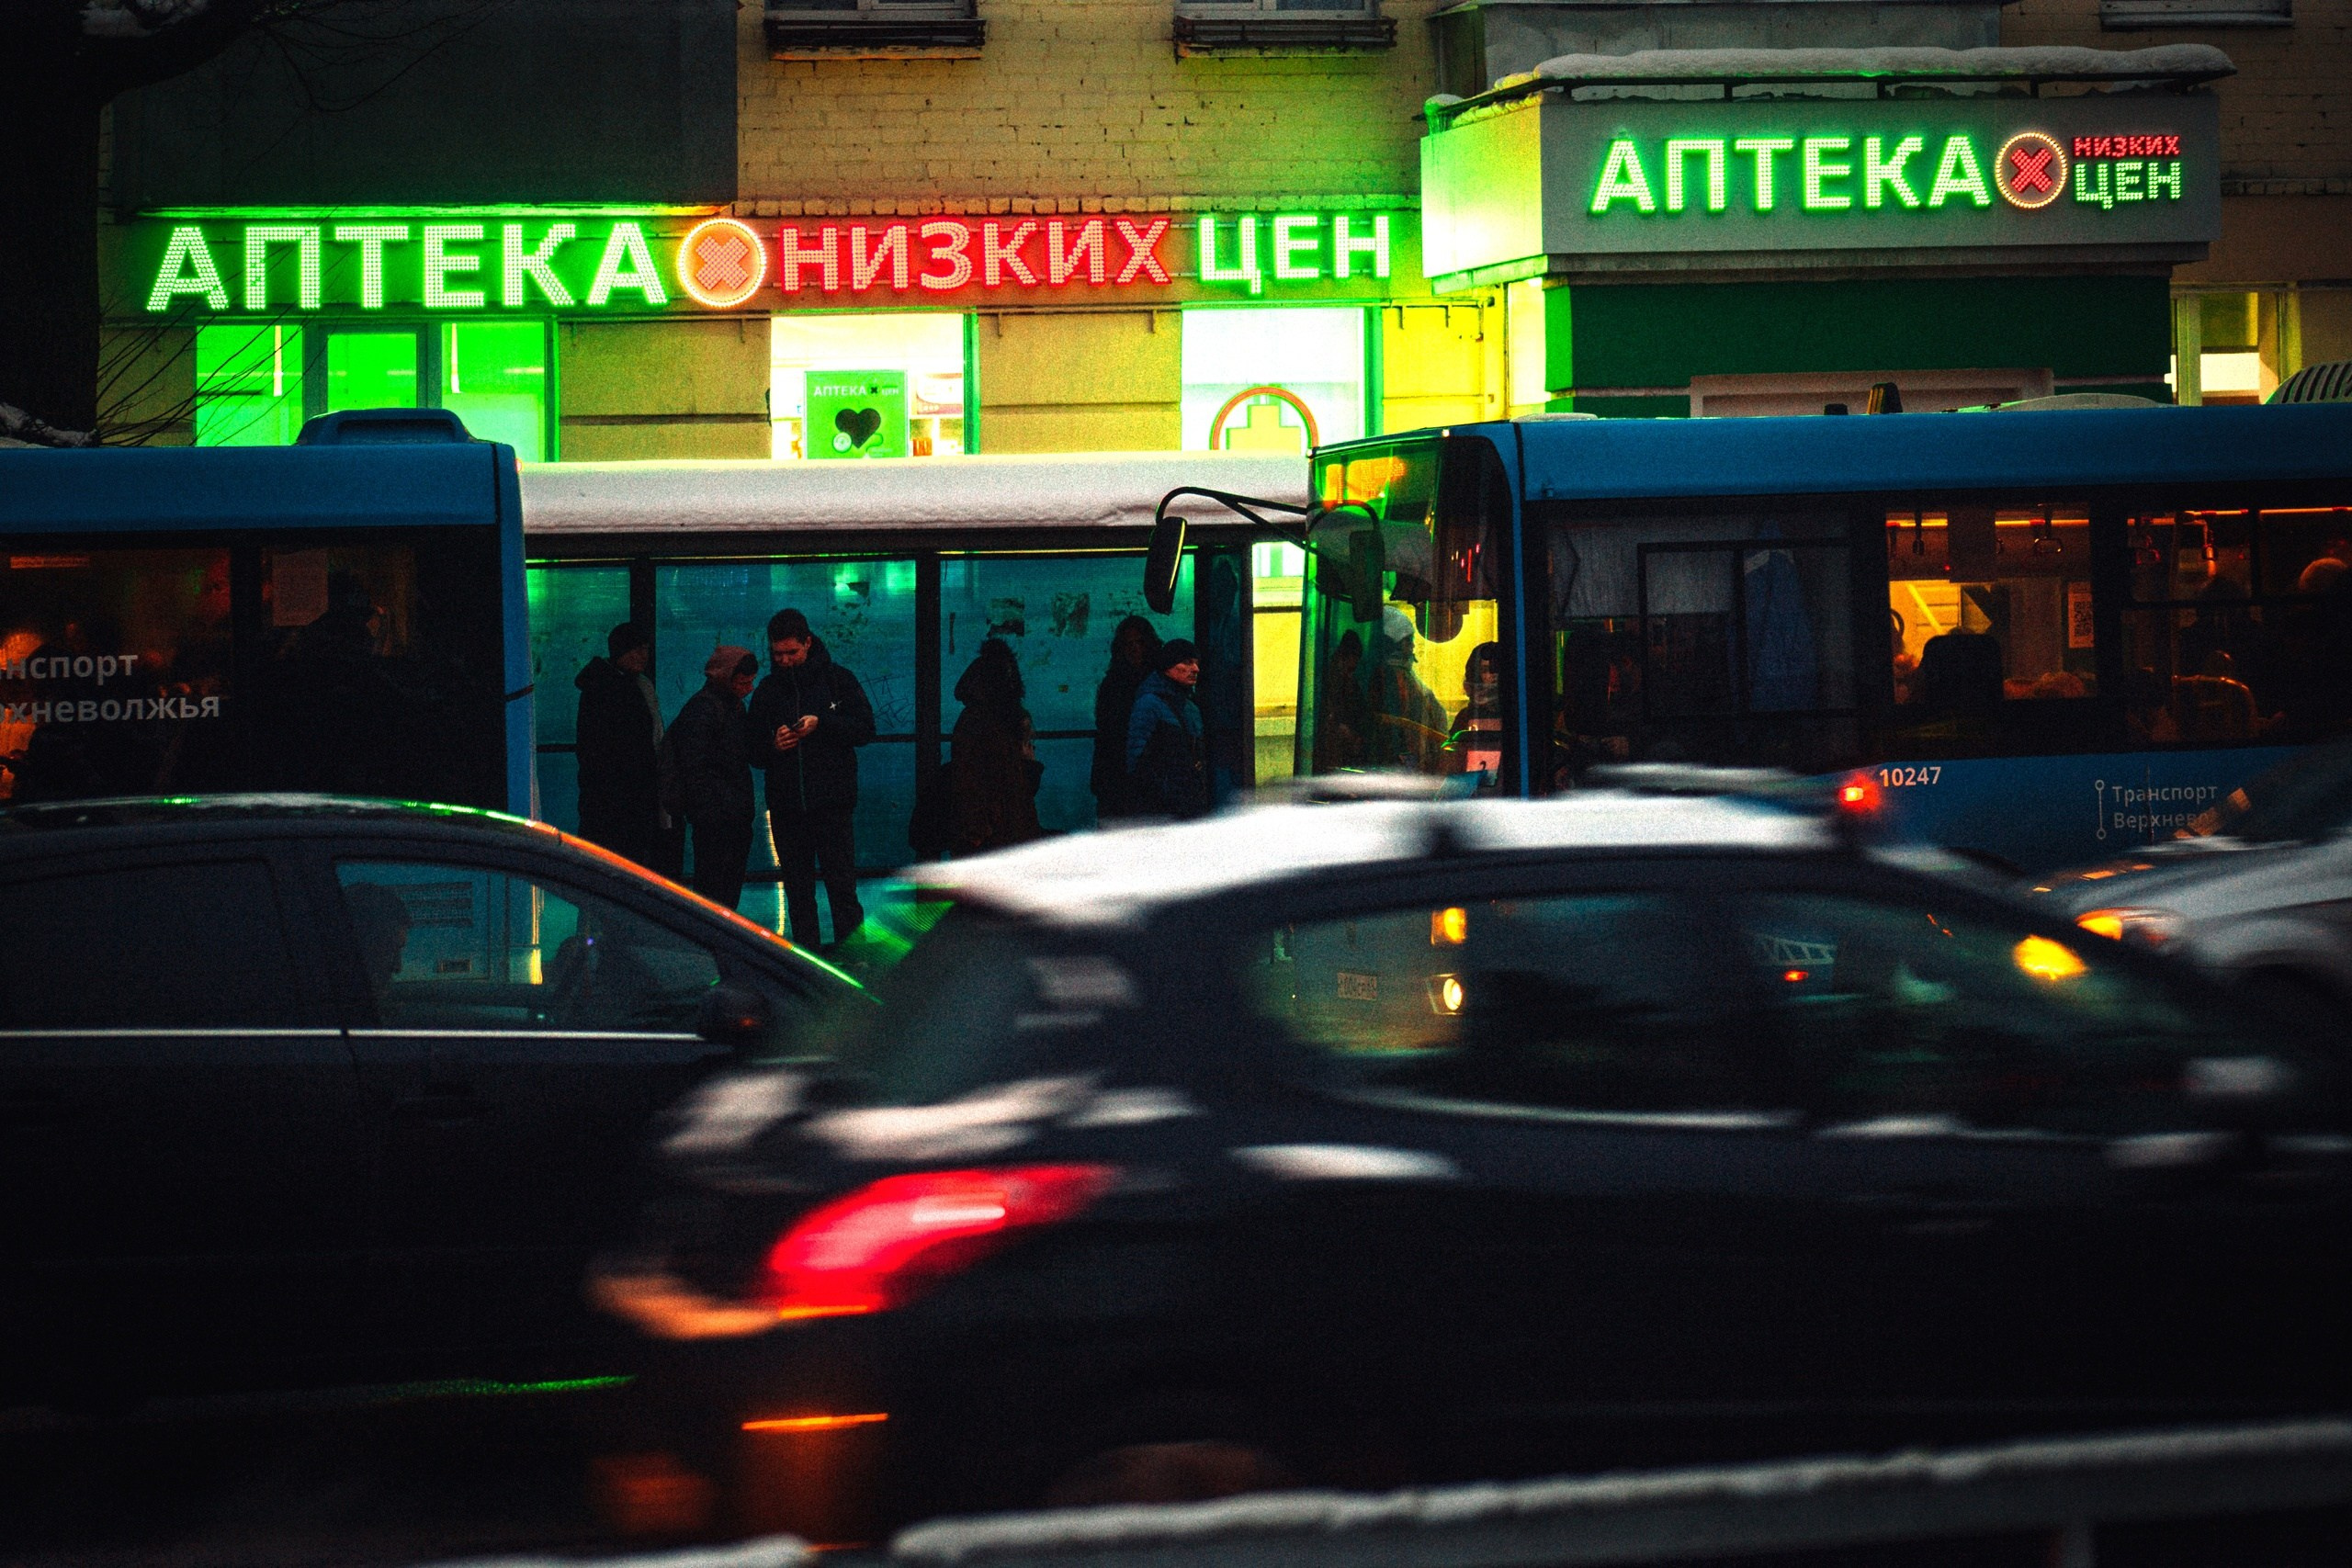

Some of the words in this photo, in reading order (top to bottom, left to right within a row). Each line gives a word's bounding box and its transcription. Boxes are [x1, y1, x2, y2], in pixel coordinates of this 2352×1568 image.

[2074, 136, 2181, 158] НИЗКИХ
[1589, 135, 1993, 214] АПТЕКА
[2075, 162, 2181, 209] ЦЕН
[146, 222, 668, 312] АПТЕКА
[780, 218, 1172, 292] НИЗКИХ
[1197, 214, 1391, 298] ЦЕН
[813, 386, 866, 397] АПТЕКА
[0, 655, 139, 686] нспорт
[1880, 766, 1941, 787] 10247
[2111, 785, 2218, 807] Транспорт
